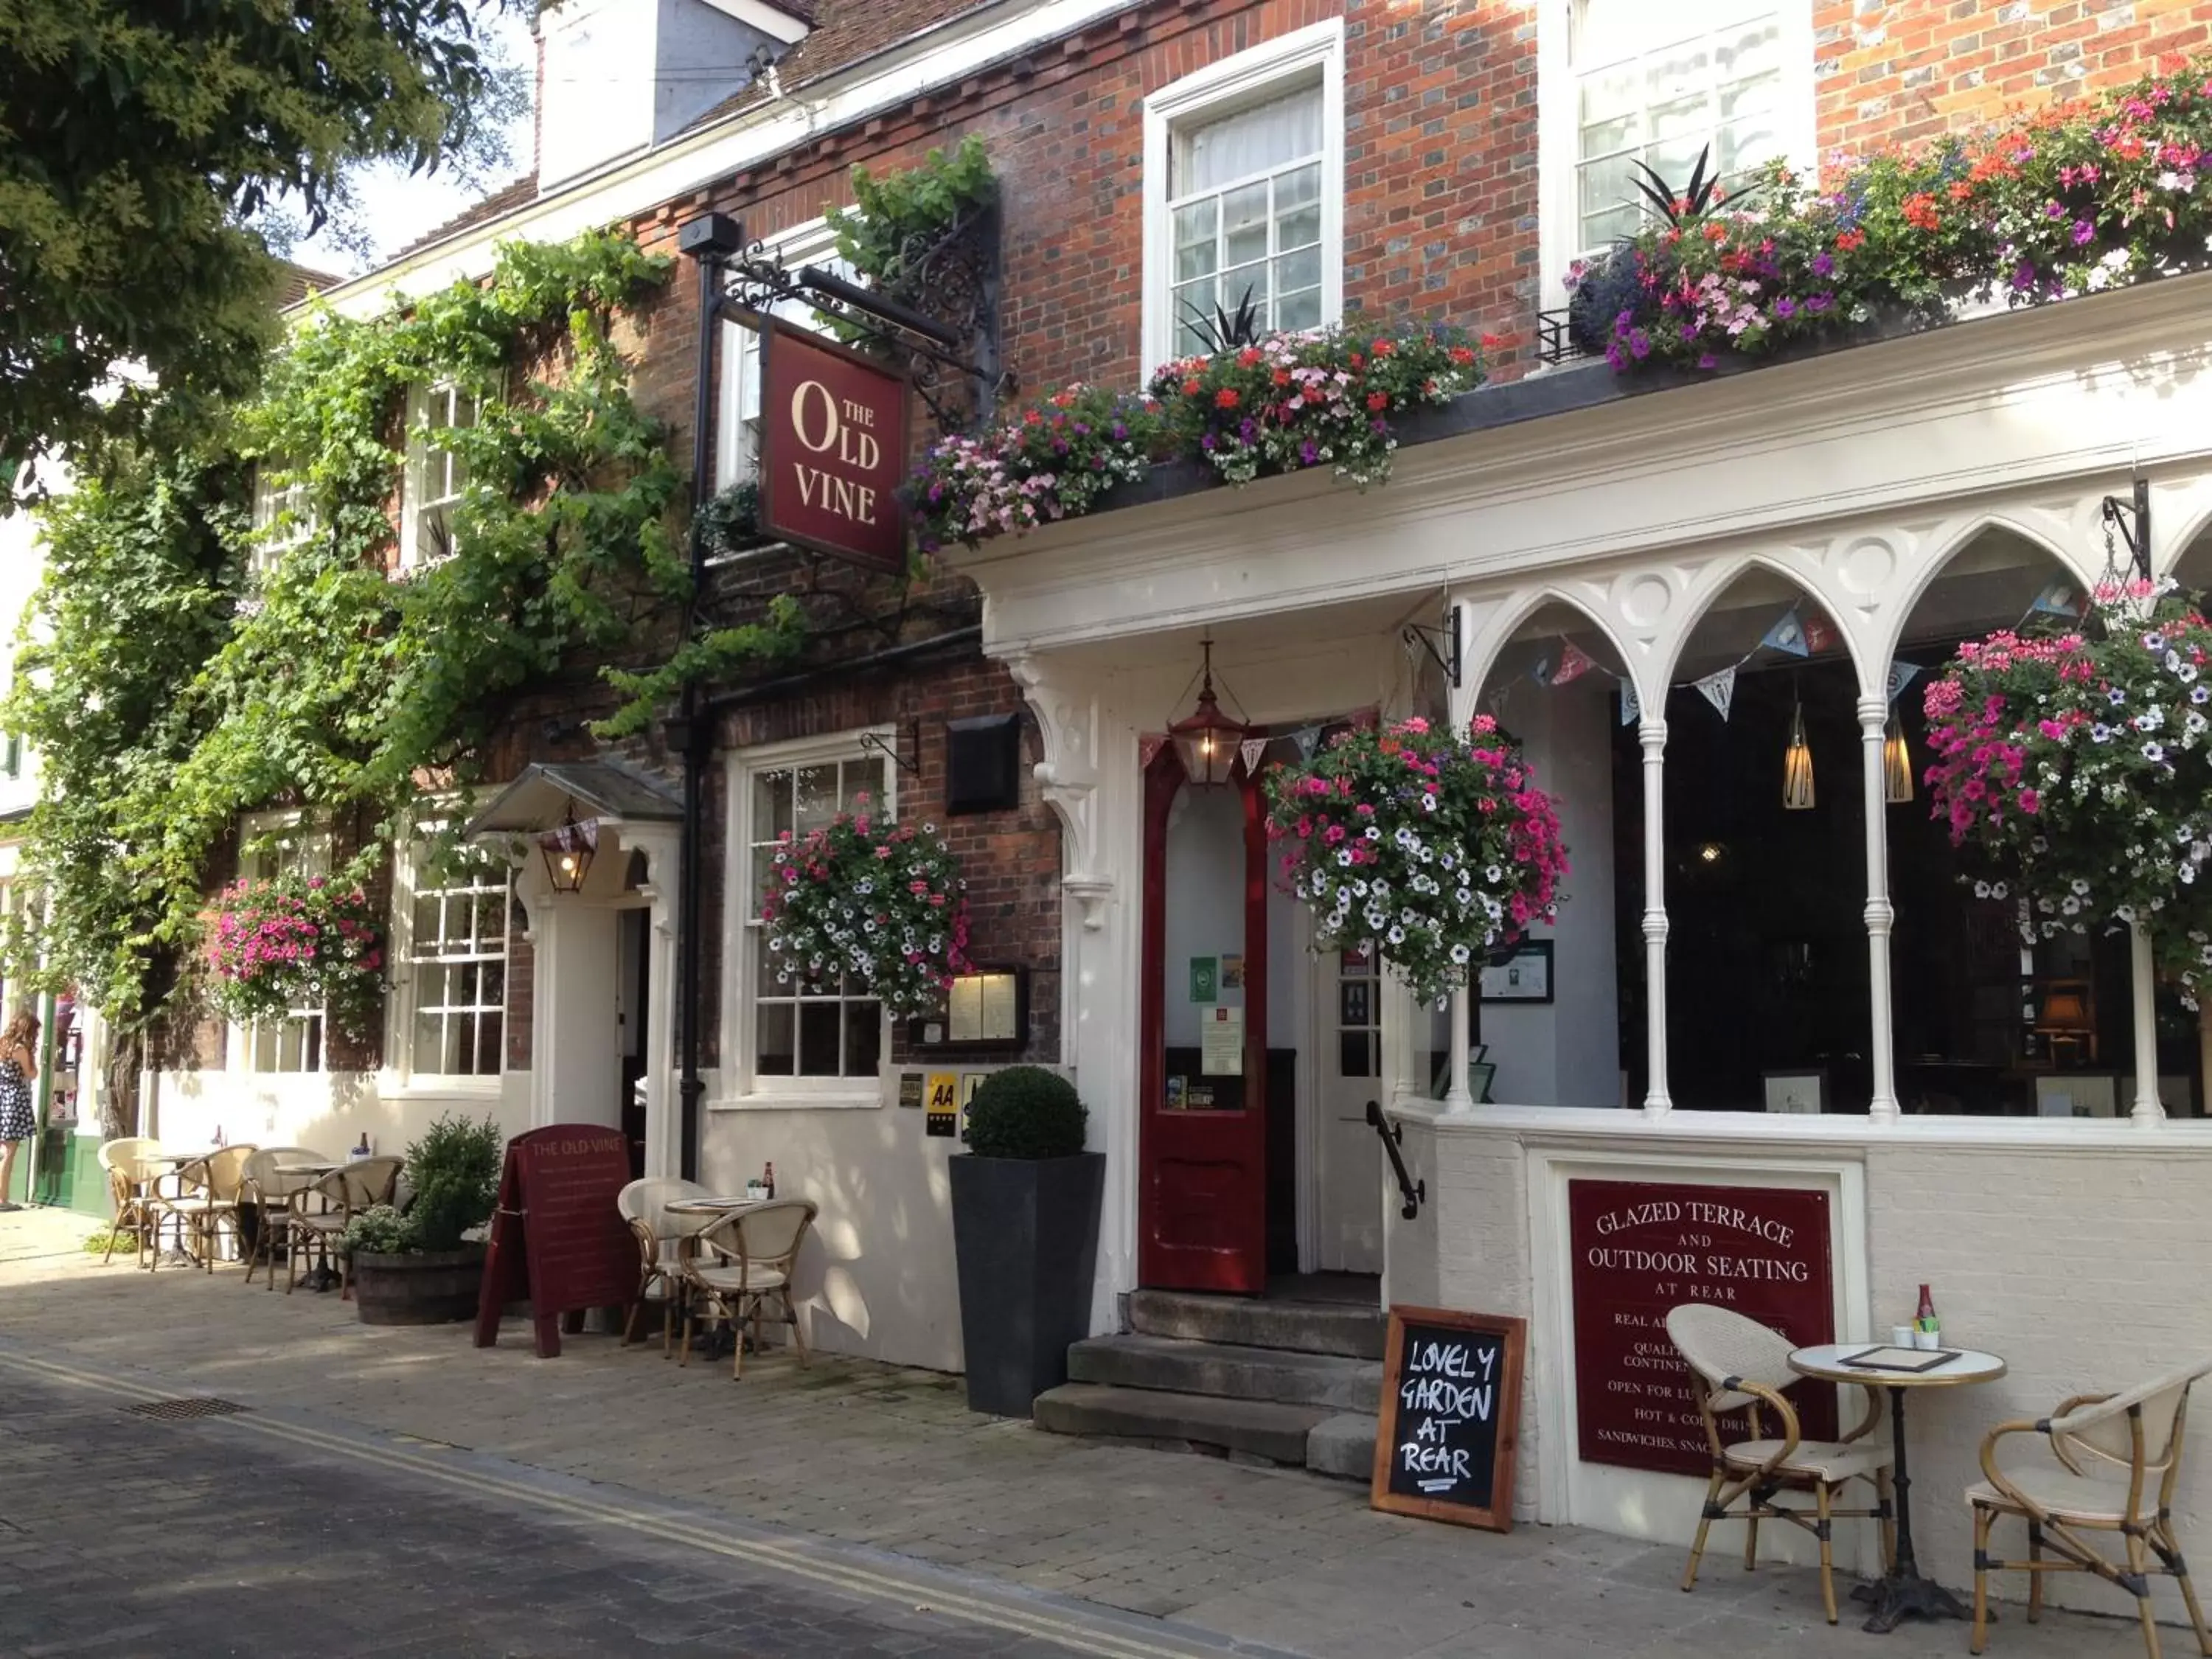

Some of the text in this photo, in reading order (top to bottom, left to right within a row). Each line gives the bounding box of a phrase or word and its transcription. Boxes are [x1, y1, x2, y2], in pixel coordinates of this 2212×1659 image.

[791, 380, 879, 470] OLD
[843, 399, 874, 428] THE
[794, 462, 876, 524] VINE
[931, 1085, 954, 1107] AA
[533, 1135, 622, 1156] THE OLD VINE
[1596, 1201, 1795, 1248] GLAZED TERRACE
[1677, 1234, 1711, 1247] AND
[1588, 1248, 1809, 1282] OUTDOOR SEATING
[1655, 1281, 1736, 1300] AT REAR
[1615, 1312, 1648, 1328] REAL
[1409, 1340, 1496, 1382] LOVELY
[1401, 1377, 1492, 1421] GARDEN
[1607, 1380, 1641, 1394] OPEN
[1646, 1384, 1672, 1398] FOR
[1416, 1416, 1461, 1443] AT
[1634, 1407, 1663, 1422] HOT
[1667, 1413, 1675, 1424] &
[1400, 1442, 1472, 1478] REAR
